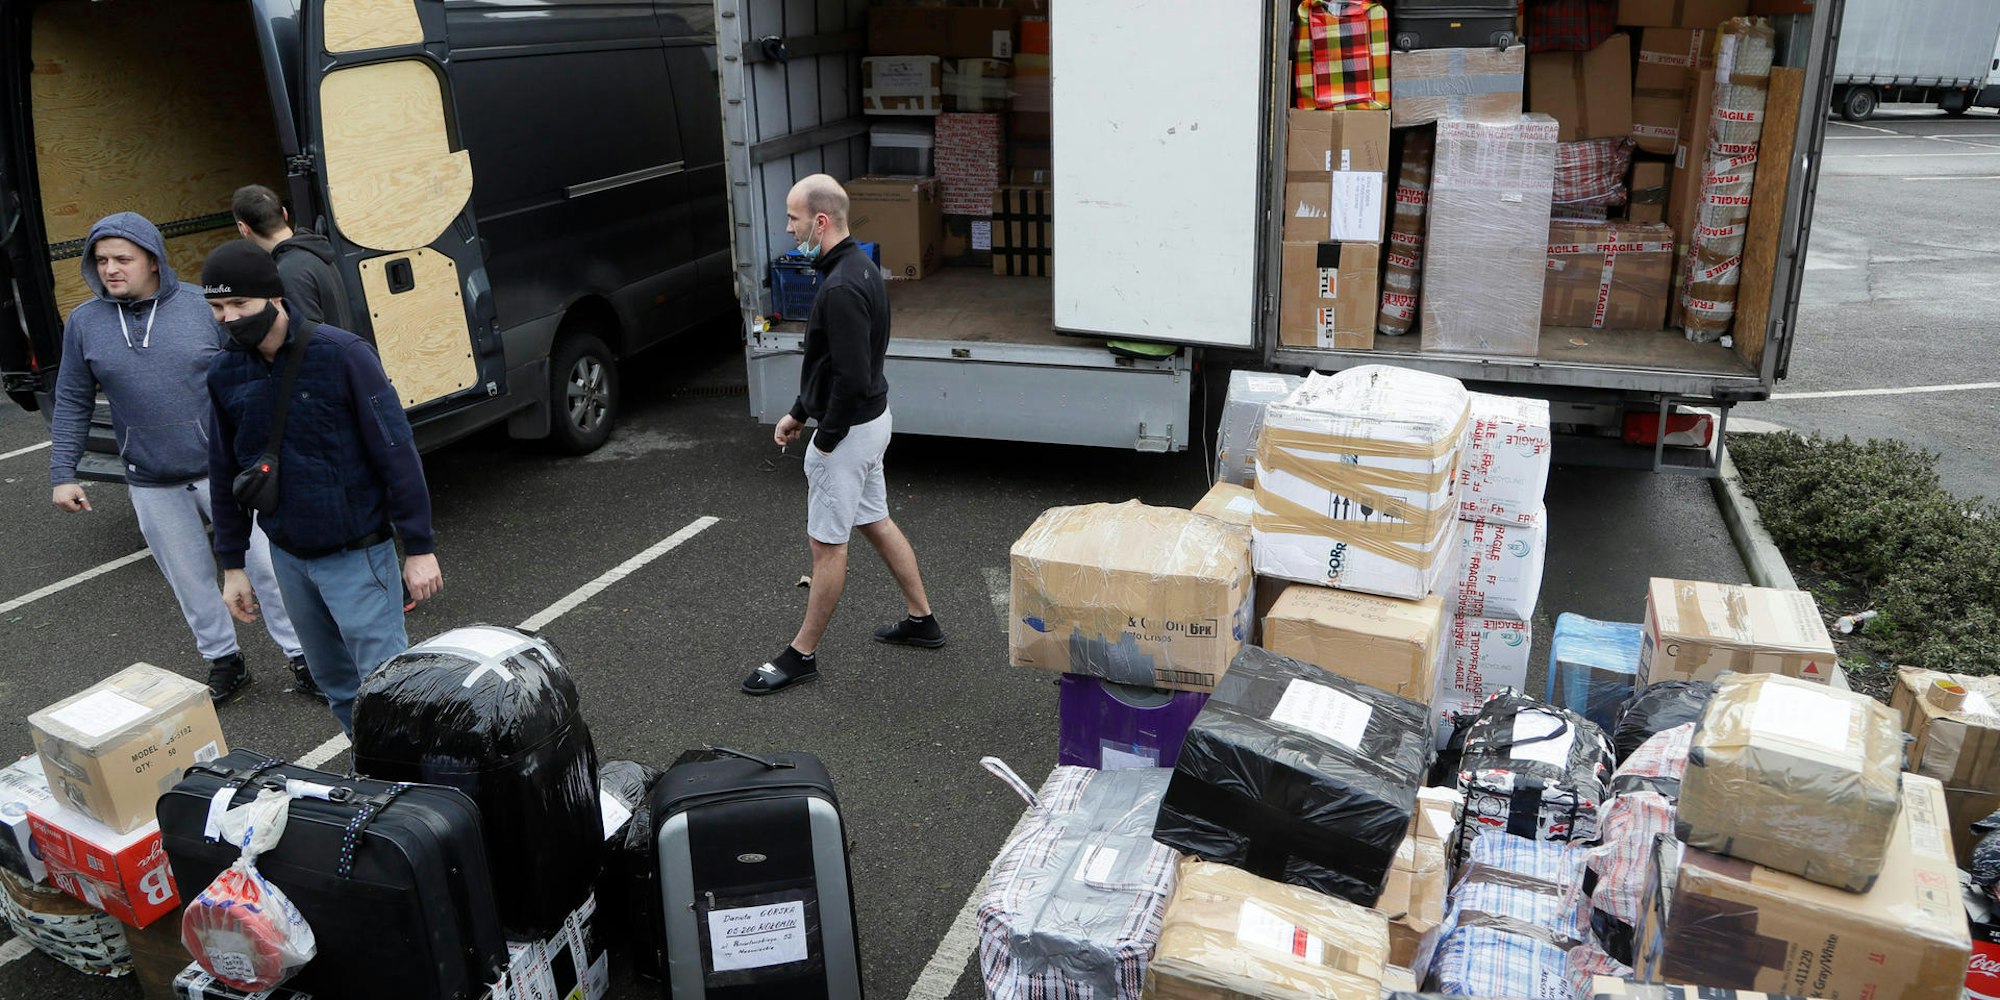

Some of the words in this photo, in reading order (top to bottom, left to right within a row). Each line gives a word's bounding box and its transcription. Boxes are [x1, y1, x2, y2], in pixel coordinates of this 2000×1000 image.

[1718, 143, 1756, 154] RAGILE
[1730, 153, 1755, 167] GILE
[1711, 195, 1750, 205] RAGILE
[1547, 244, 1579, 254] AGILE
[1596, 243, 1643, 253] FRAGILE
[1594, 283, 1609, 326] FRAGILE
[1127, 615, 1137, 628] &
[1483, 619, 1525, 630] FRAGILE
[167, 748, 177, 758] 50
[1814, 933, 1840, 987] Gray/White
[1794, 950, 1815, 987] 411229
